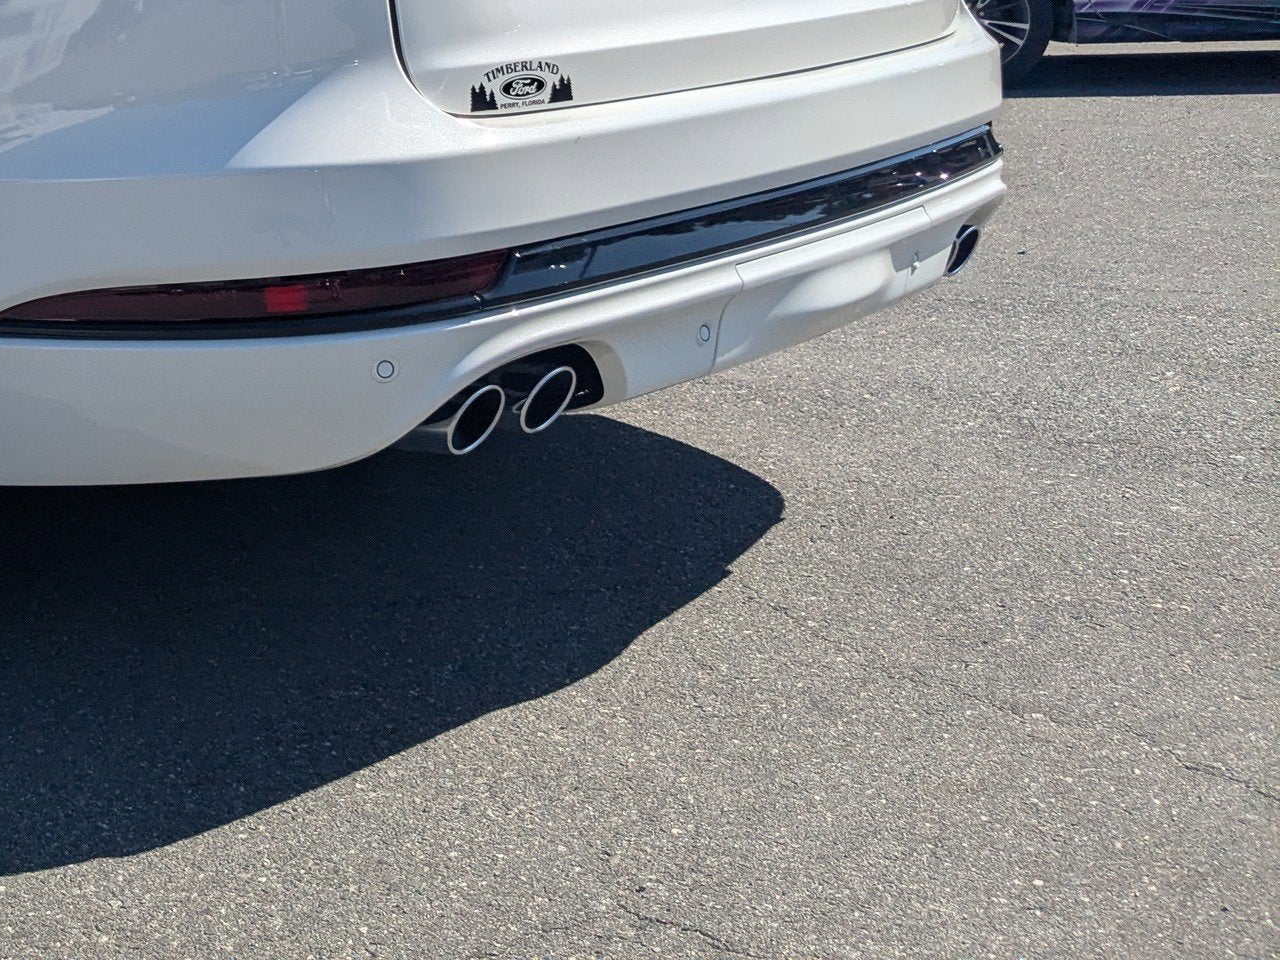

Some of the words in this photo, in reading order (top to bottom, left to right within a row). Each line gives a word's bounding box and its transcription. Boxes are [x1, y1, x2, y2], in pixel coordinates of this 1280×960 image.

[483, 60, 560, 83] TIMBERLAND
[509, 79, 538, 96] Ford
[500, 101, 520, 110] PERRY,
[521, 99, 546, 107] FLORIDA
